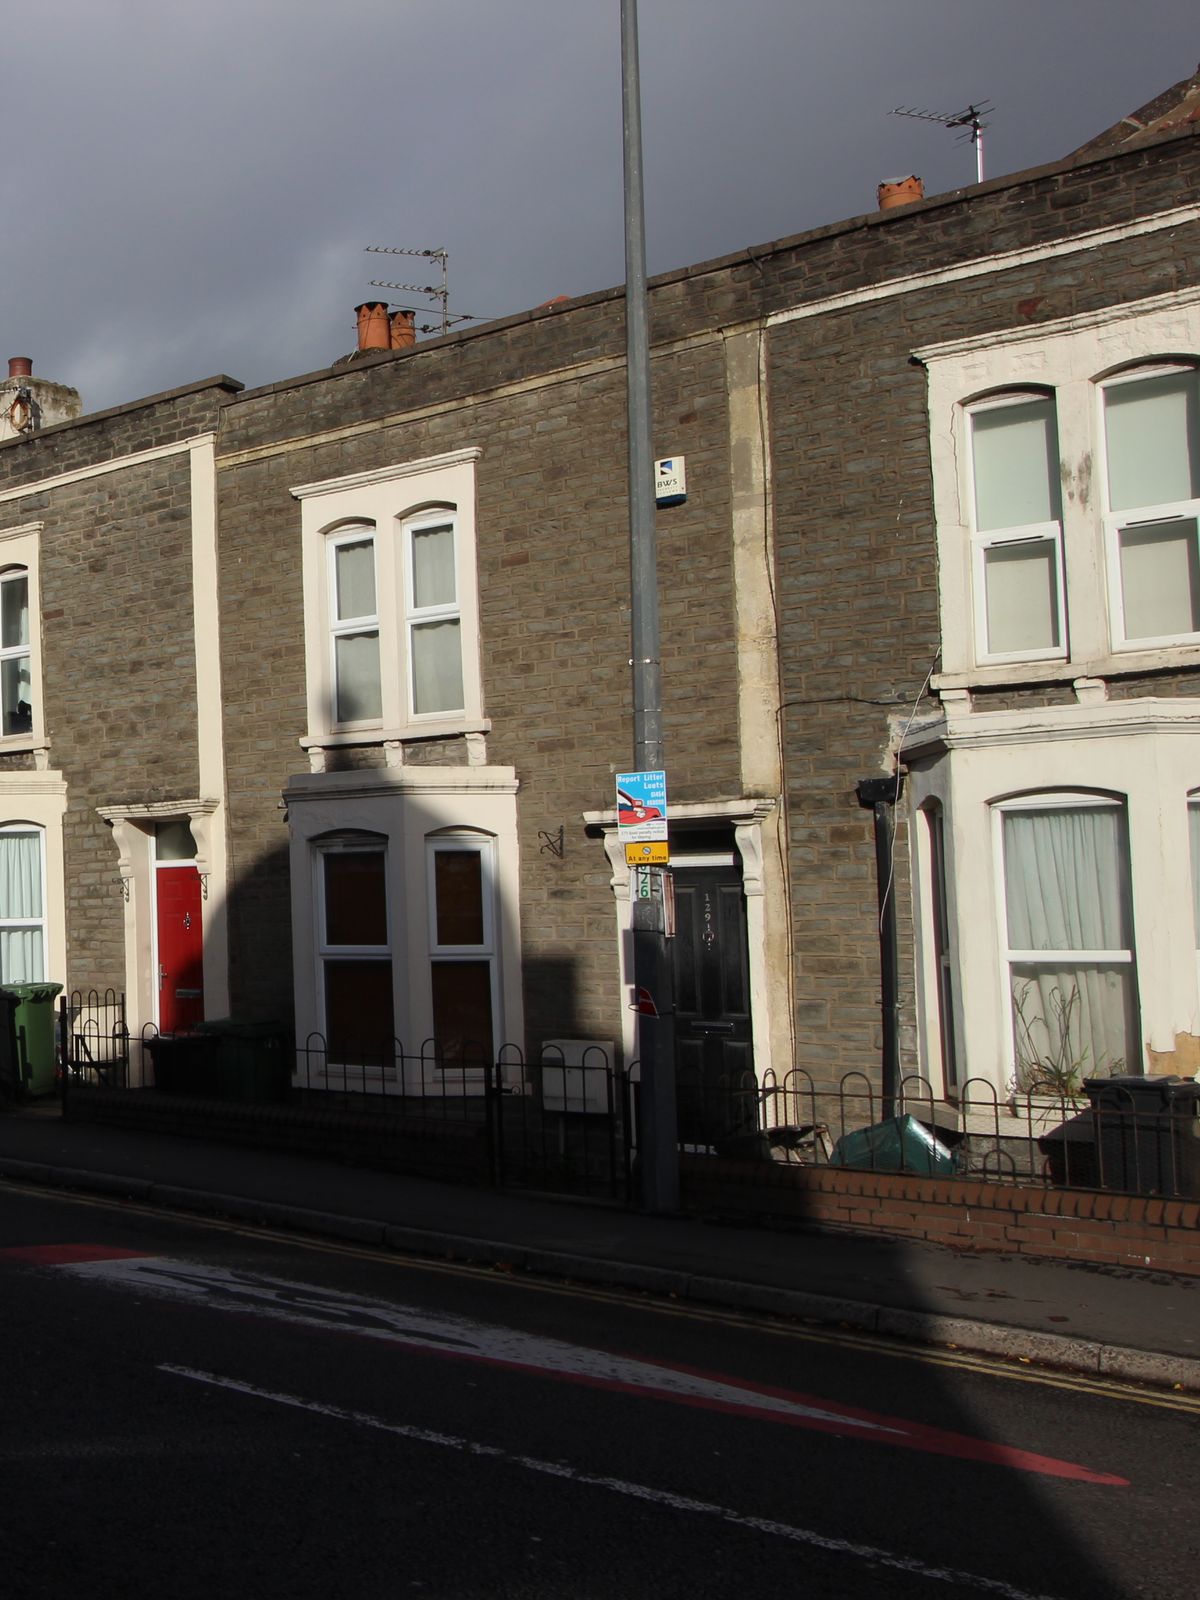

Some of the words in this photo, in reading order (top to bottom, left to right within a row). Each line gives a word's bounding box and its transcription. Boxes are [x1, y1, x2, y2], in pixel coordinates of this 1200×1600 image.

[657, 478, 678, 488] BWS
[617, 775, 640, 784] Report
[643, 773, 664, 782] Litter
[704, 893, 712, 922] 129
